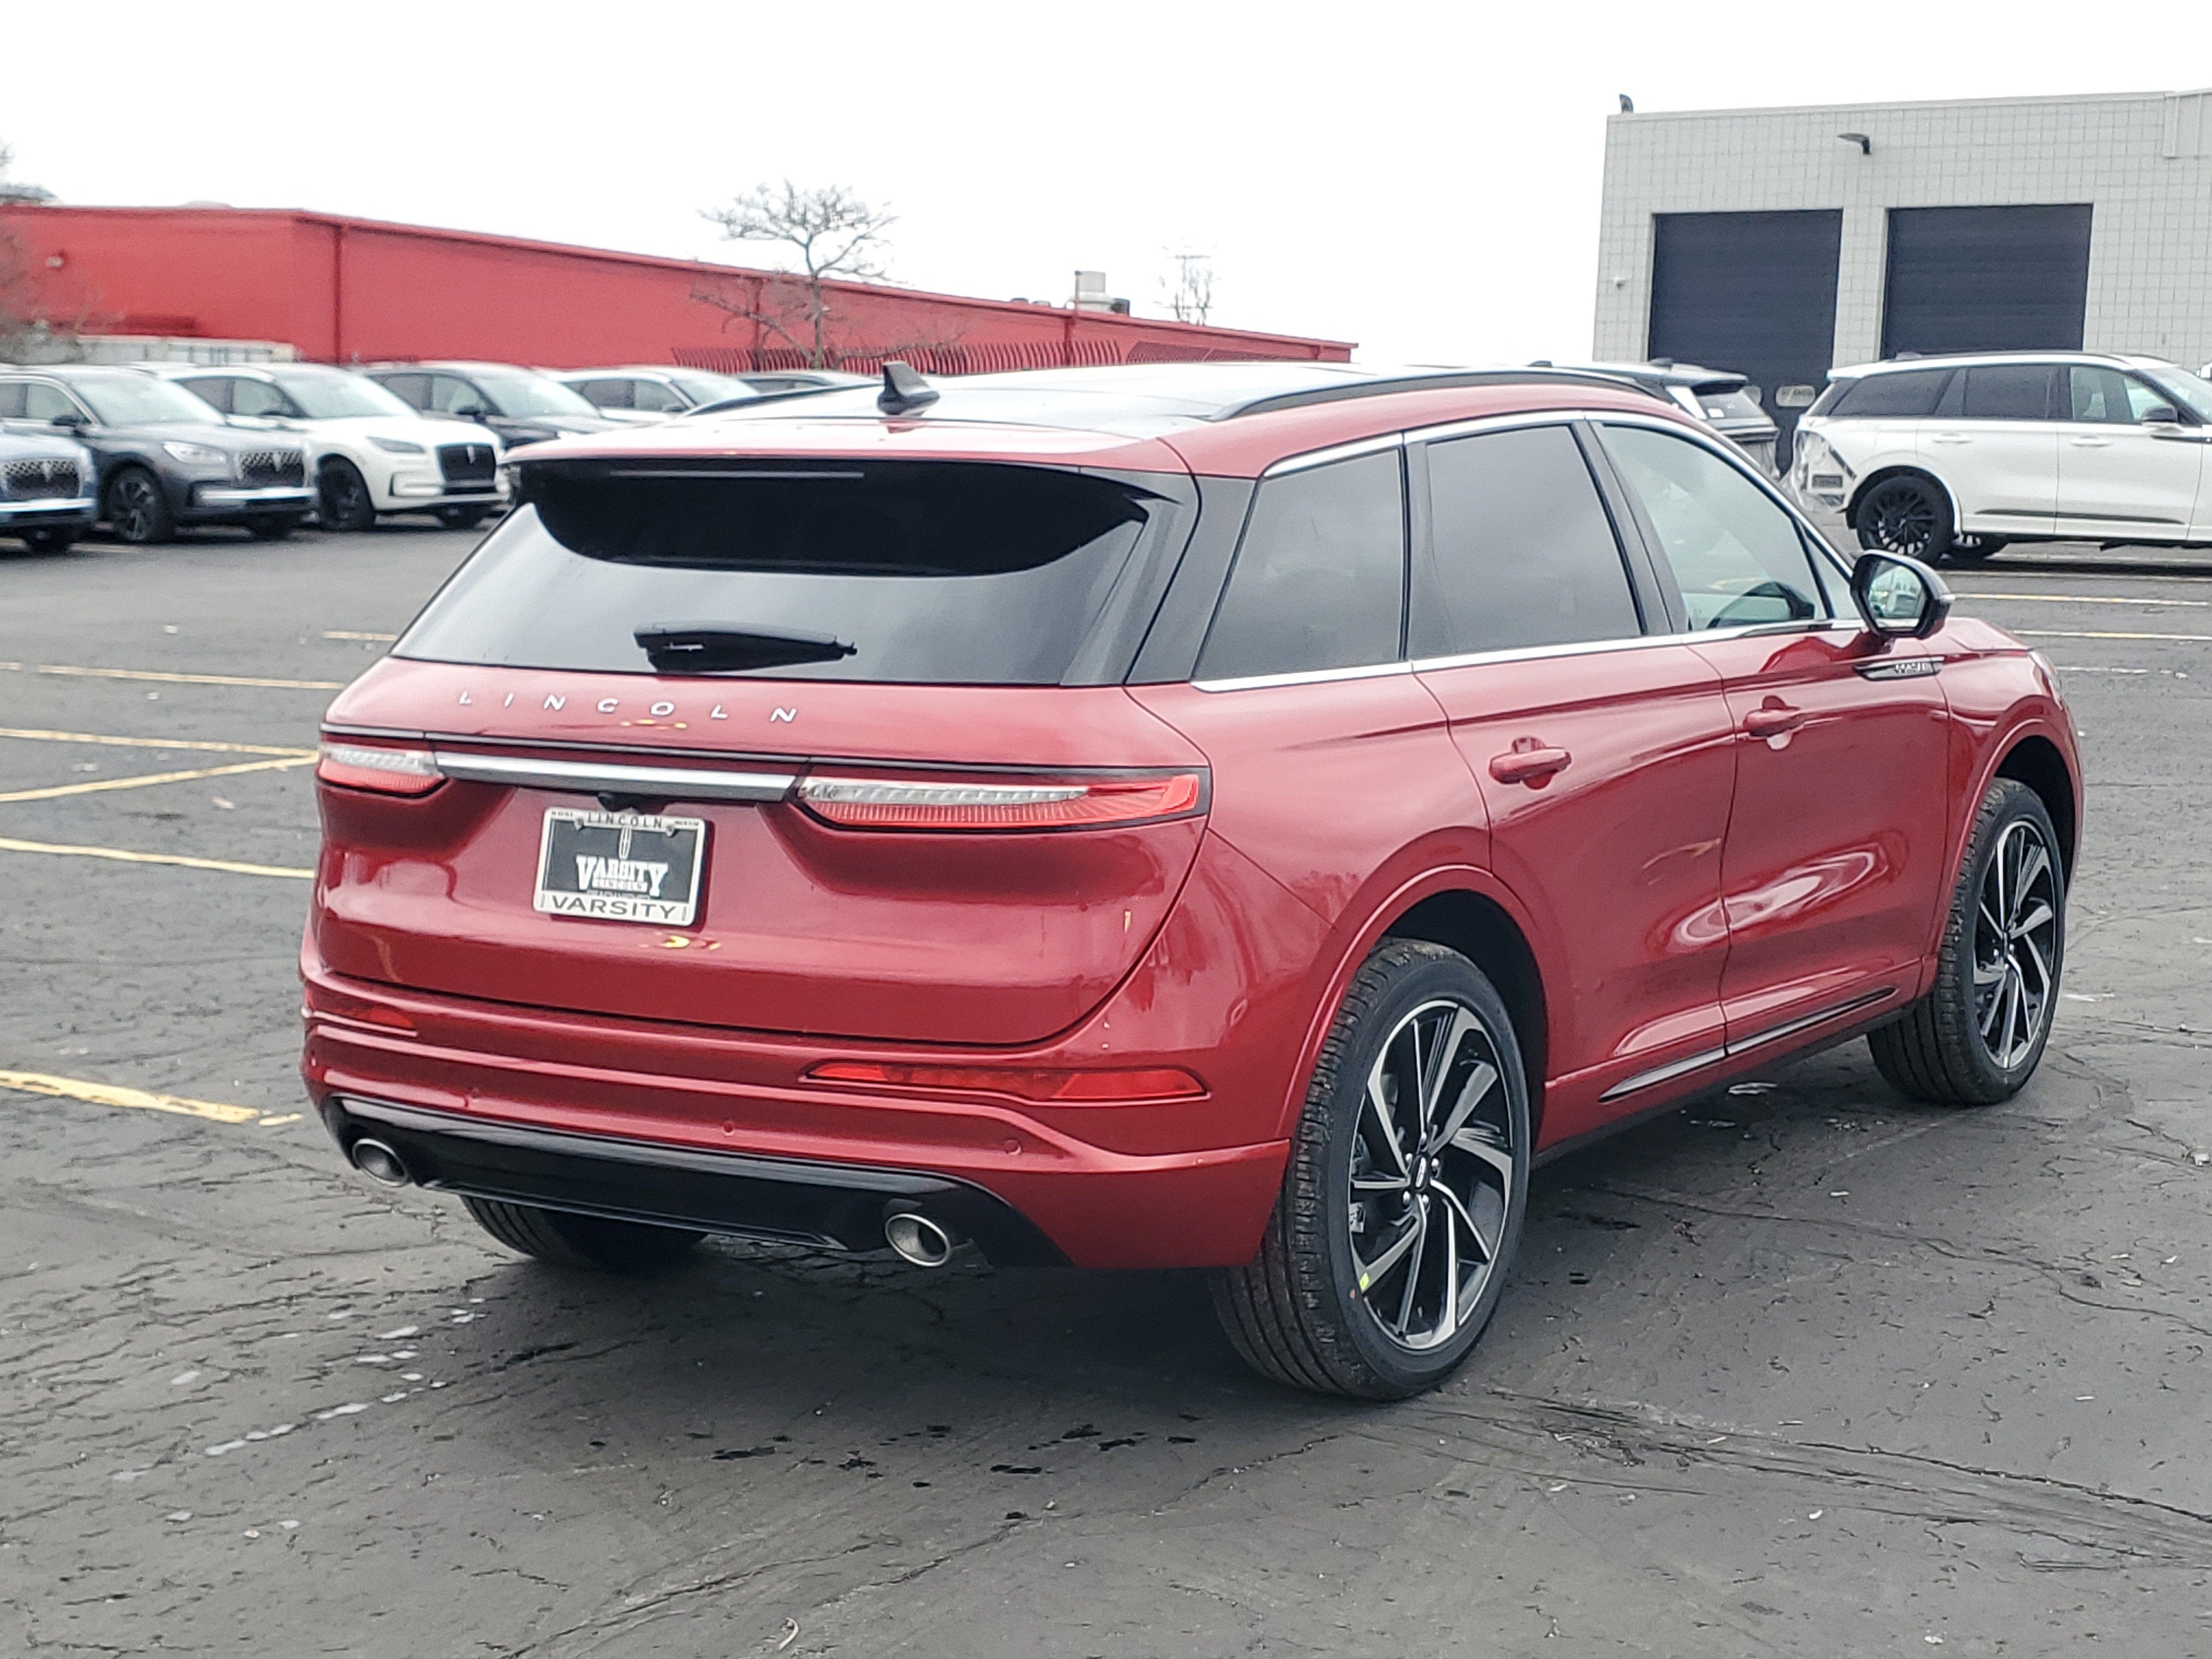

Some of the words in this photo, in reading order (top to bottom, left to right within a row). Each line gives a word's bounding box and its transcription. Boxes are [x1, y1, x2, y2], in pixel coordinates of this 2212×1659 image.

[459, 691, 797, 723] LINCOLN
[588, 811, 662, 828] LINCOLN
[576, 855, 668, 897] VARSITY
[552, 895, 676, 919] VARSITY
